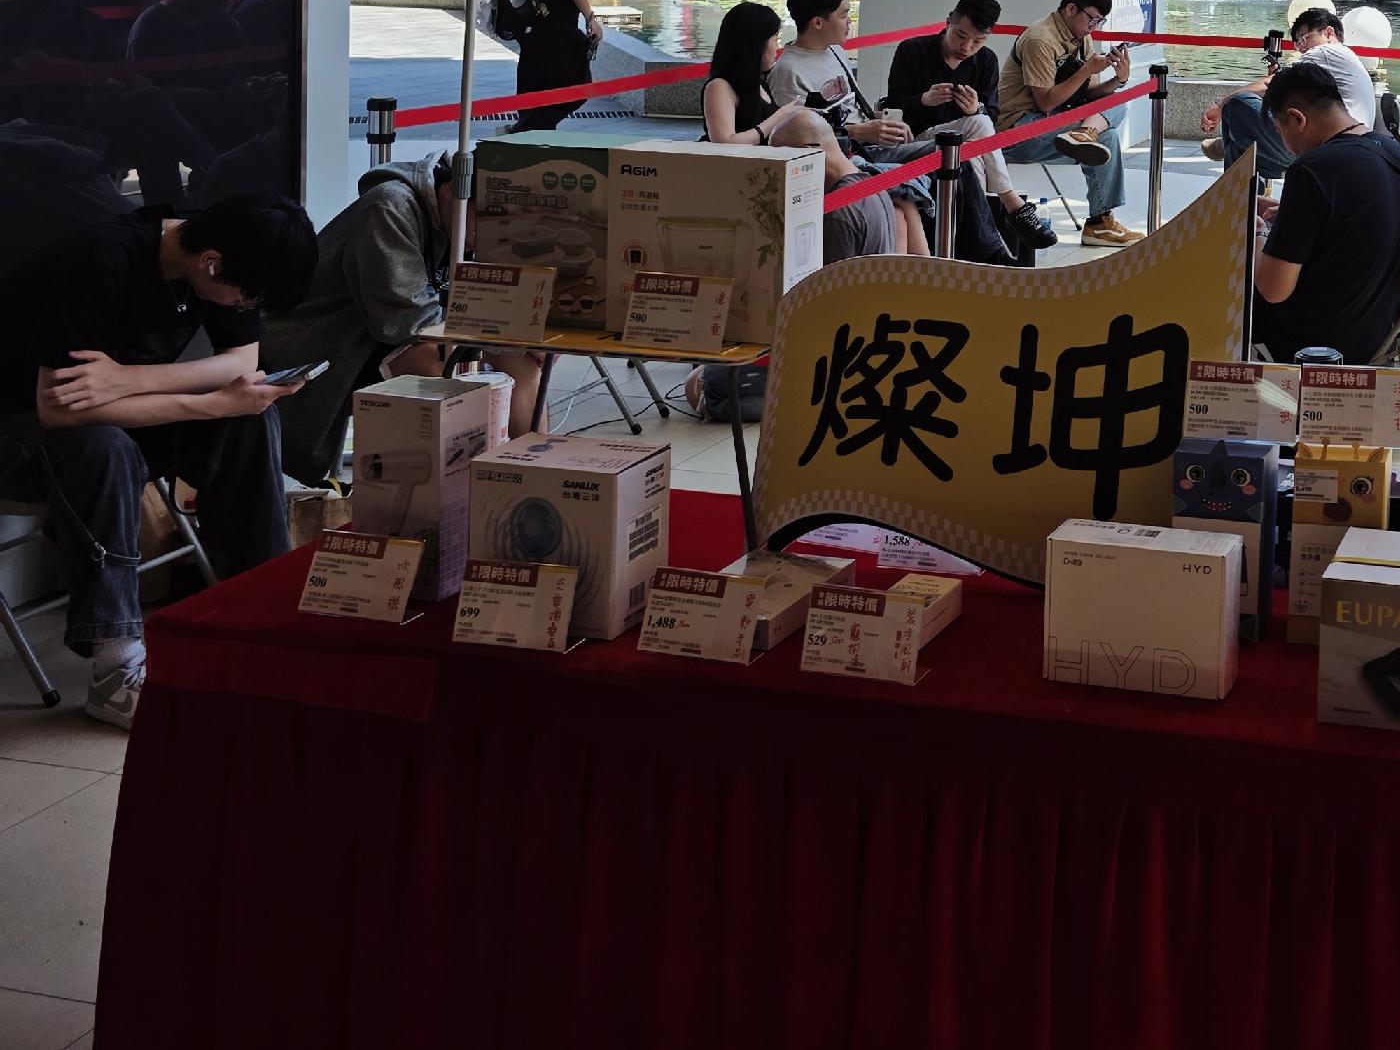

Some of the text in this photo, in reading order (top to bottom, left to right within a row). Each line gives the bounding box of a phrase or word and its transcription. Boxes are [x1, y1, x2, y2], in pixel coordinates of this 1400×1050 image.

[466, 266, 515, 283] 限時特價
[646, 278, 694, 295] 限時特價
[628, 311, 648, 324] 500
[1202, 364, 1257, 382] 限時特價
[1316, 371, 1369, 388] 限時特價
[798, 312, 1191, 521] 燦坤
[1188, 403, 1209, 415] 500
[1302, 410, 1323, 422] 500
[561, 480, 600, 491] SANLUX
[329, 536, 381, 554] 限時特價
[477, 565, 532, 583] 限時特價
[1183, 563, 1212, 575] HYD
[308, 575, 327, 588] 500
[665, 574, 721, 594] 限時特價
[824, 591, 880, 613] 限時特價
[459, 606, 481, 618] 699
[647, 614, 677, 630] 1,488
[806, 633, 828, 647] 529
[1048, 636, 1198, 696] HYD
